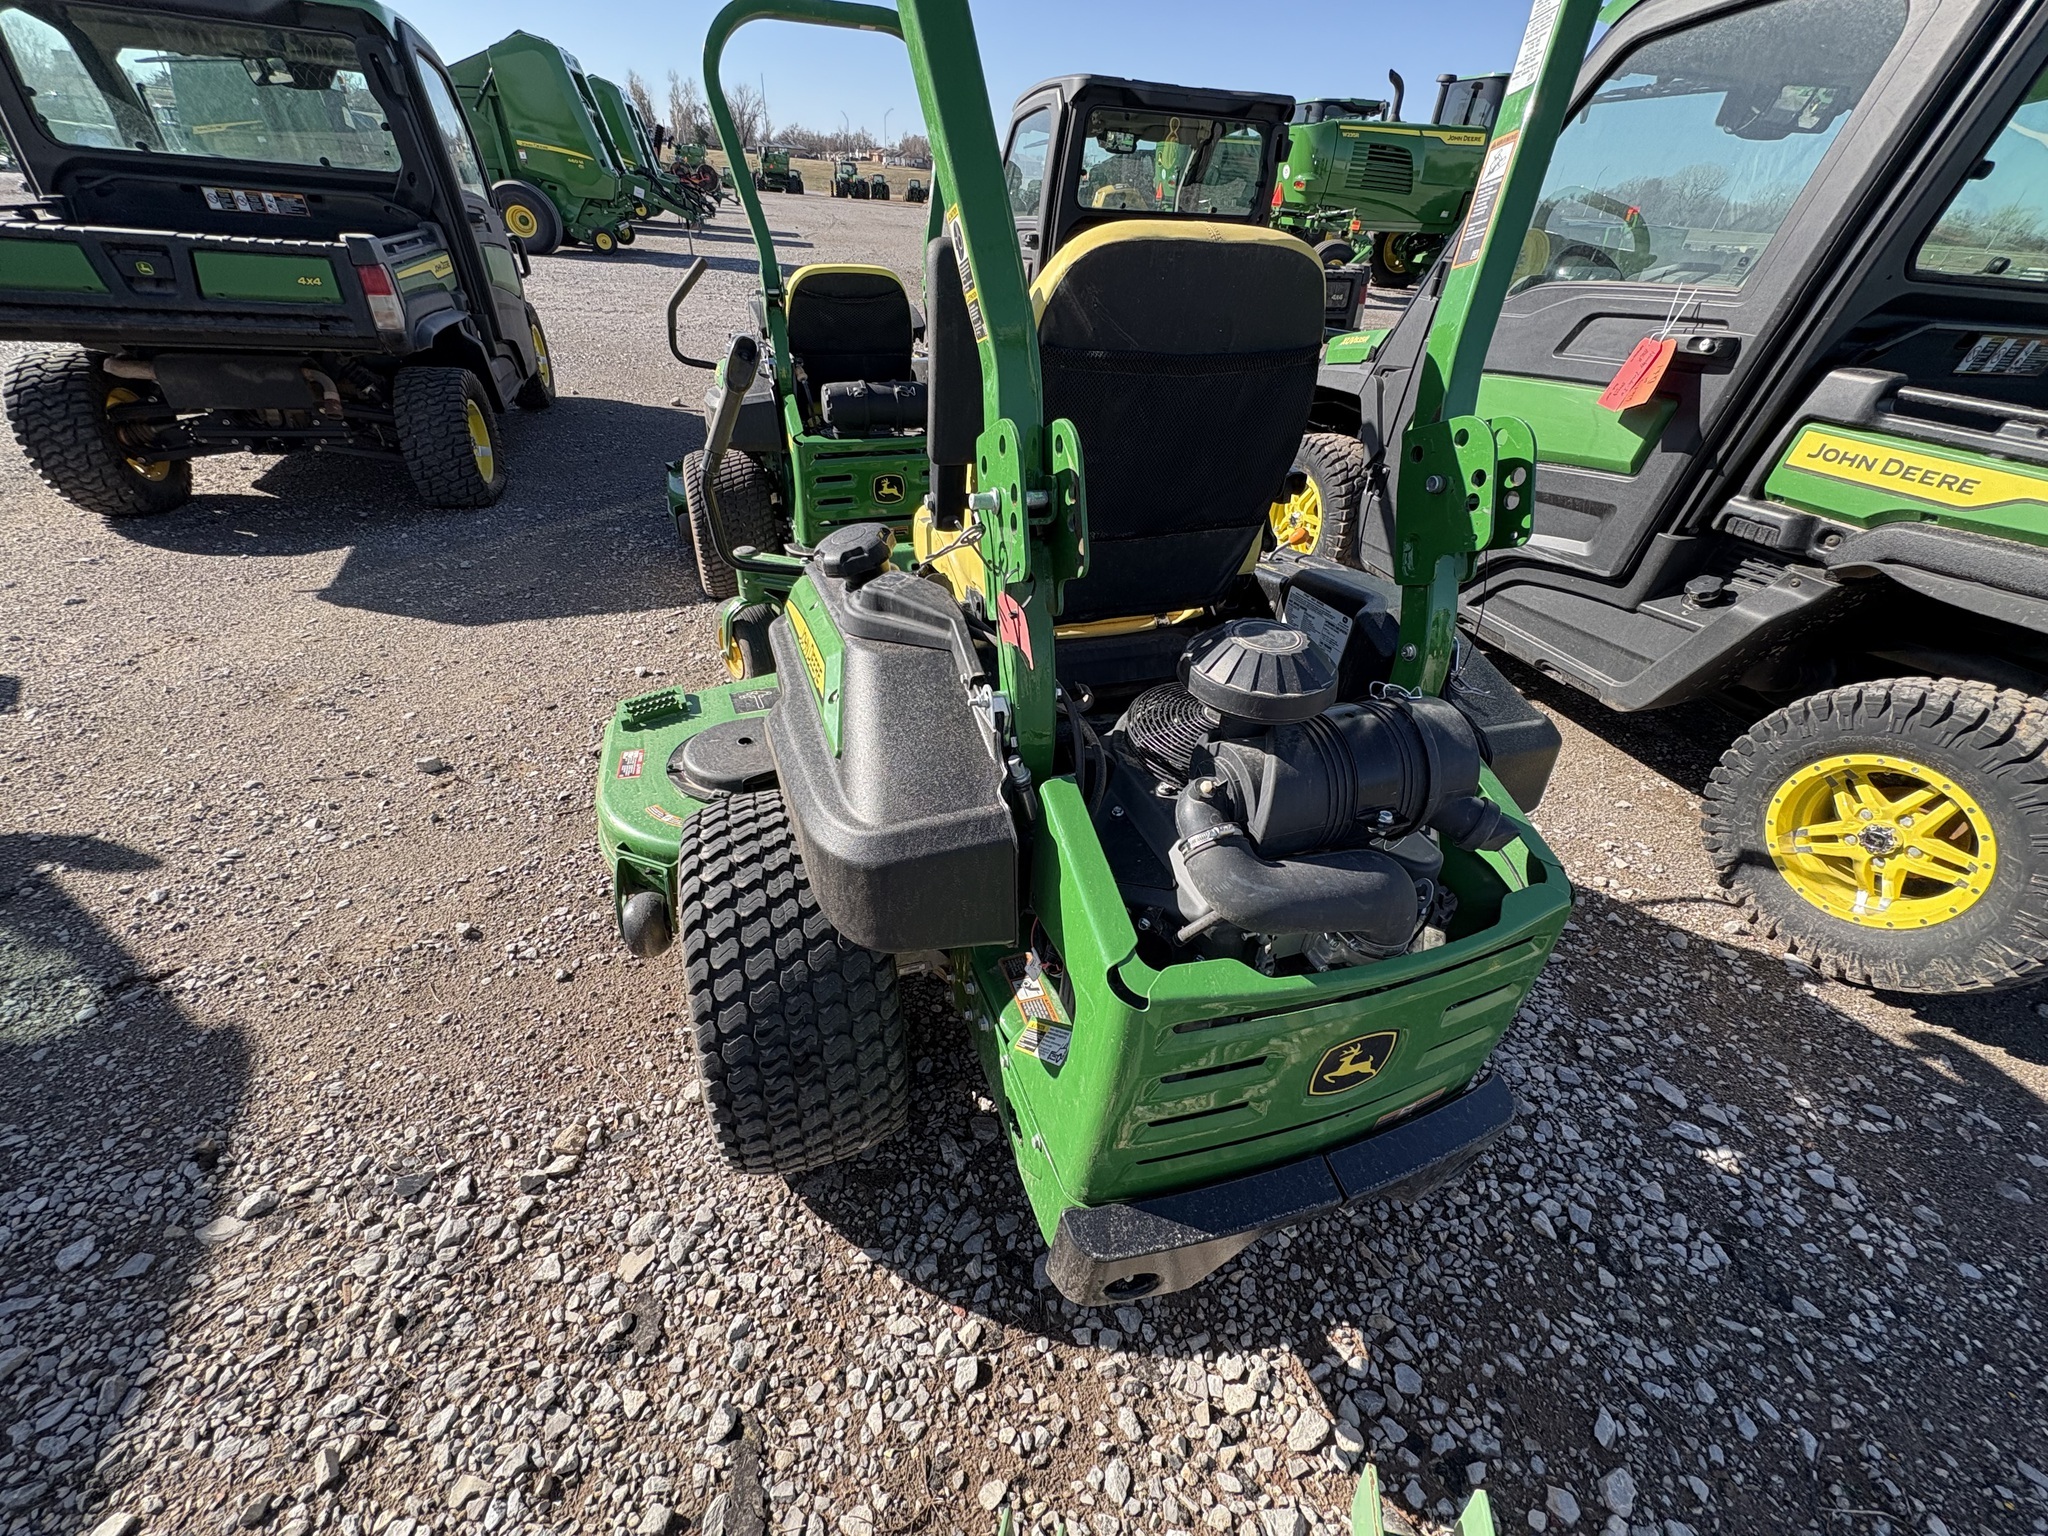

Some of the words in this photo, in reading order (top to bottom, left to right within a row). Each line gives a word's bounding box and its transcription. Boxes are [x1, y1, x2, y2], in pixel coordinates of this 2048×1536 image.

[1463, 134, 1482, 142] DEERE
[297, 276, 322, 286] 4x4
[1807, 443, 1878, 472] JOHN
[1879, 457, 1981, 495] DEERE
